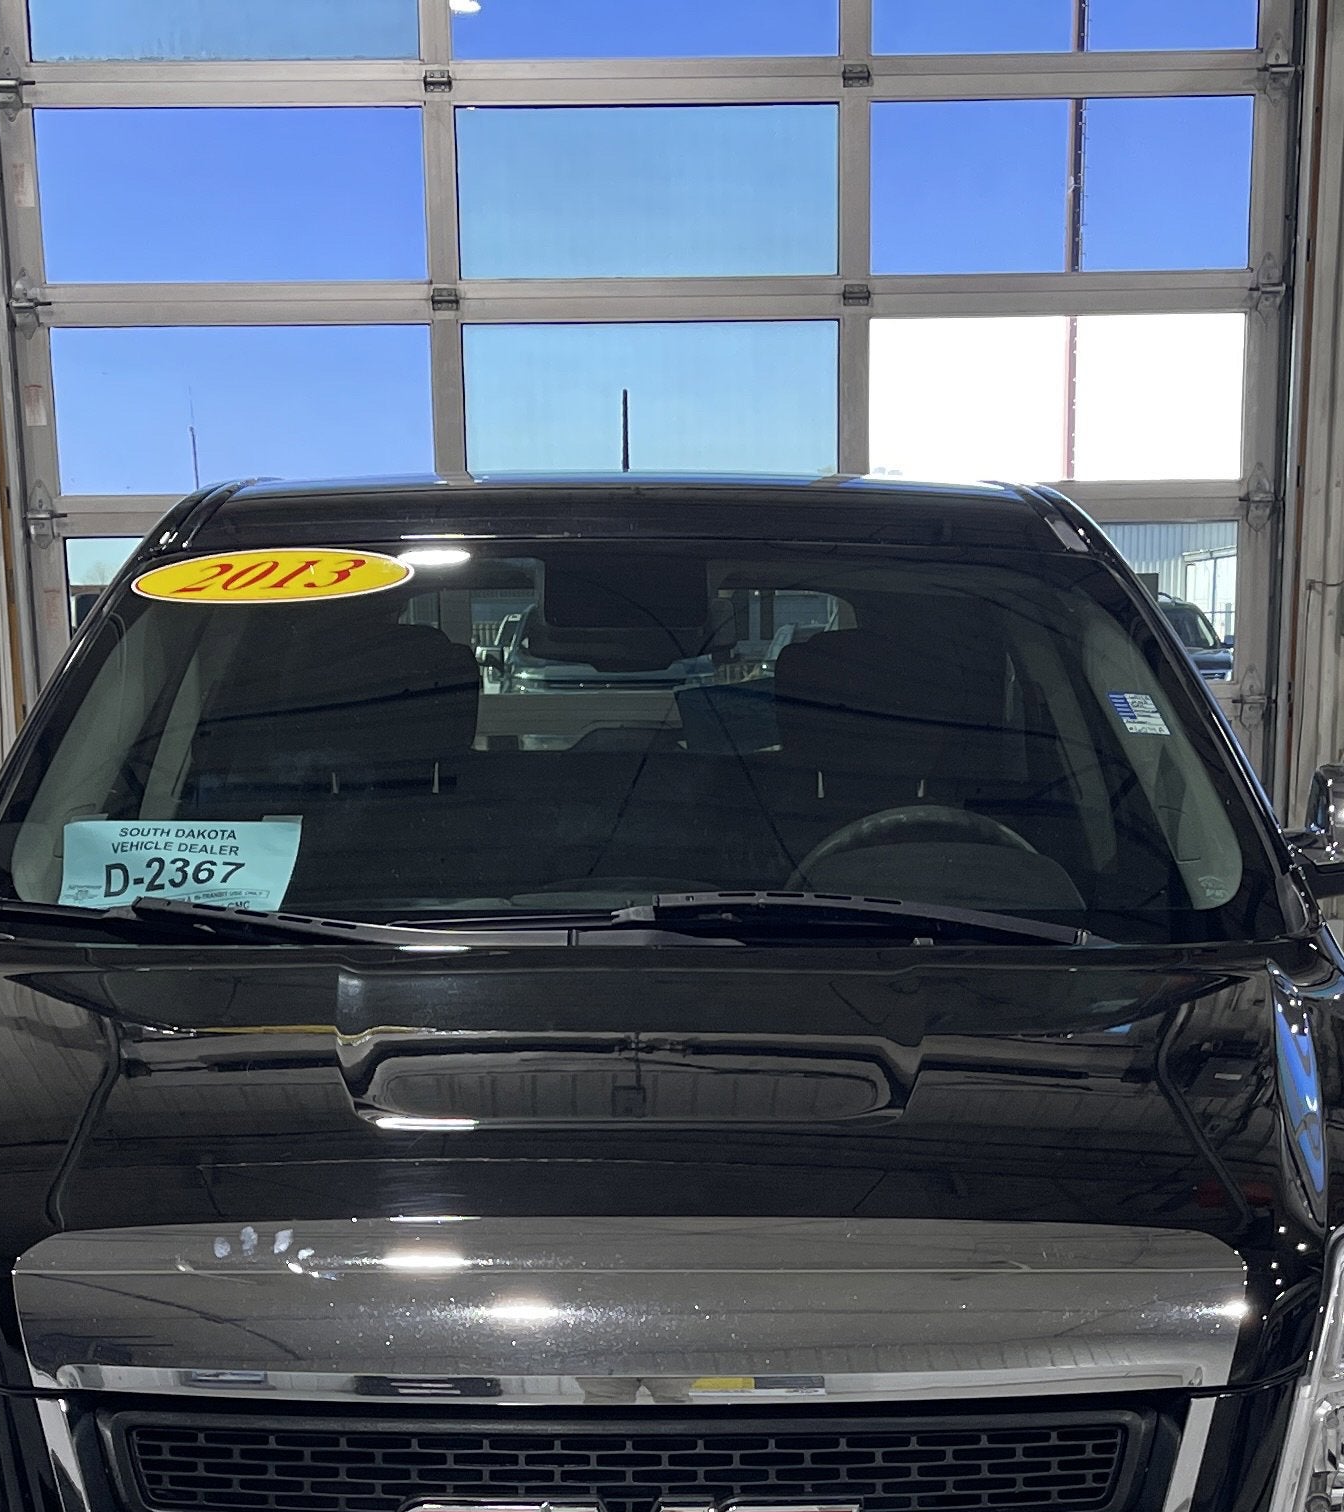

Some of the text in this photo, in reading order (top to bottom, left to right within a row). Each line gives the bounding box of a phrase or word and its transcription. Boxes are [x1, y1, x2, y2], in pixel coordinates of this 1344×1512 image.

[169, 559, 367, 593] 2013
[118, 827, 237, 840] SOUTH DAKOTA
[111, 841, 240, 856] VEHICLE DEALER
[103, 857, 246, 898] D-2367
